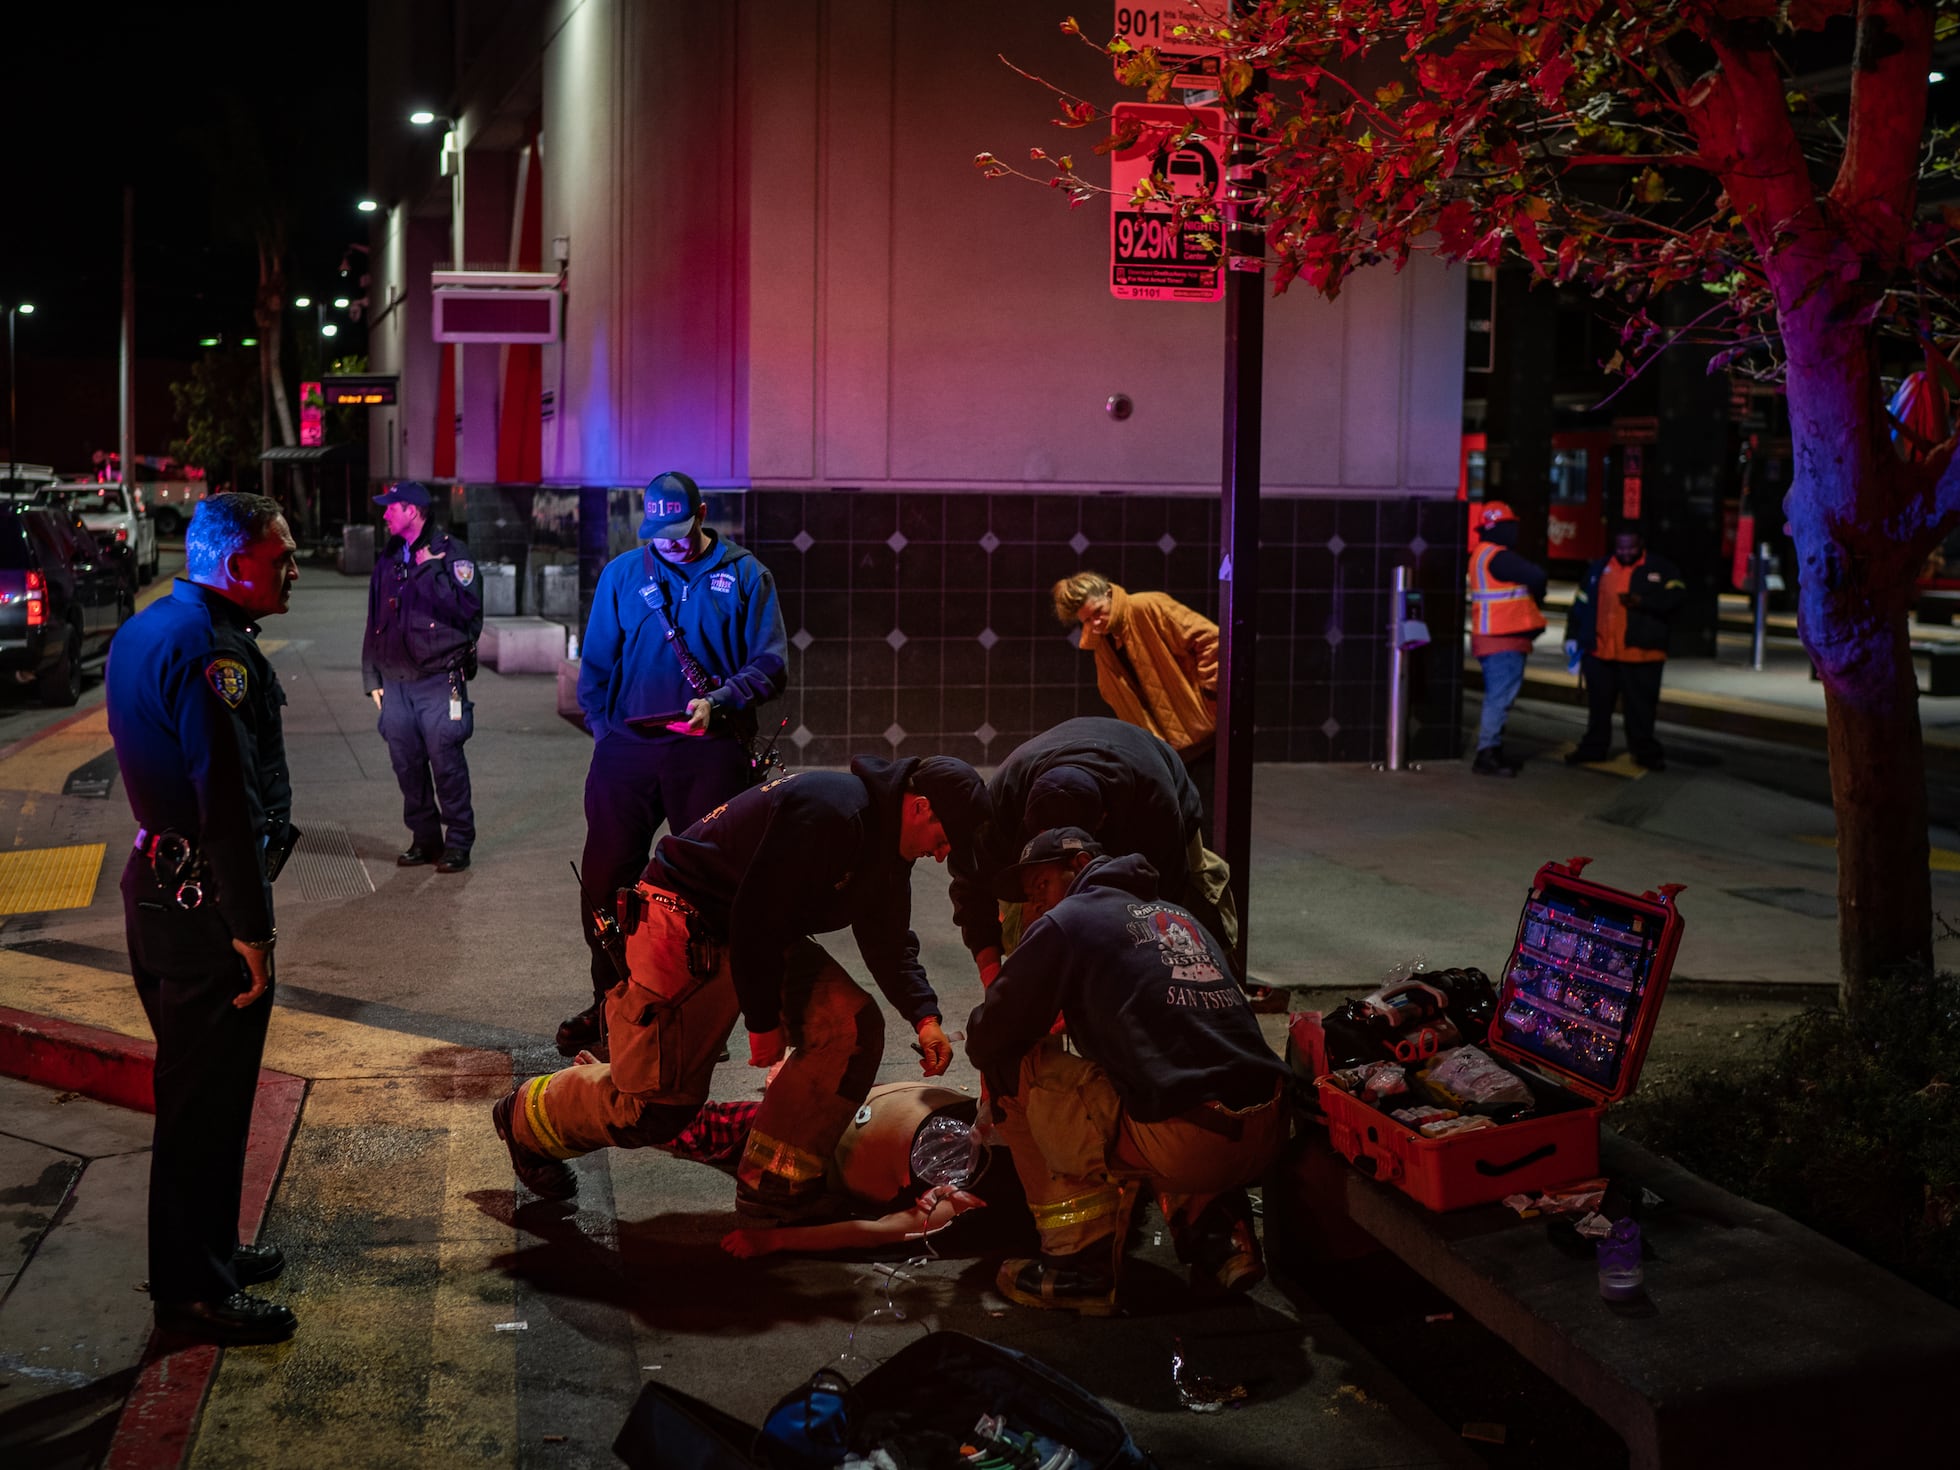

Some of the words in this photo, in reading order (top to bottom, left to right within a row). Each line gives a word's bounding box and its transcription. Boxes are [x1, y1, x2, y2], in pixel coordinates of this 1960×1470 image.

[1117, 8, 1160, 38] 901
[1183, 221, 1220, 231] NIGHTS
[1118, 218, 1178, 259] 929N
[1183, 251, 1207, 261] Center
[1132, 288, 1160, 298] 91101
[1166, 985, 1198, 1008] SAN
